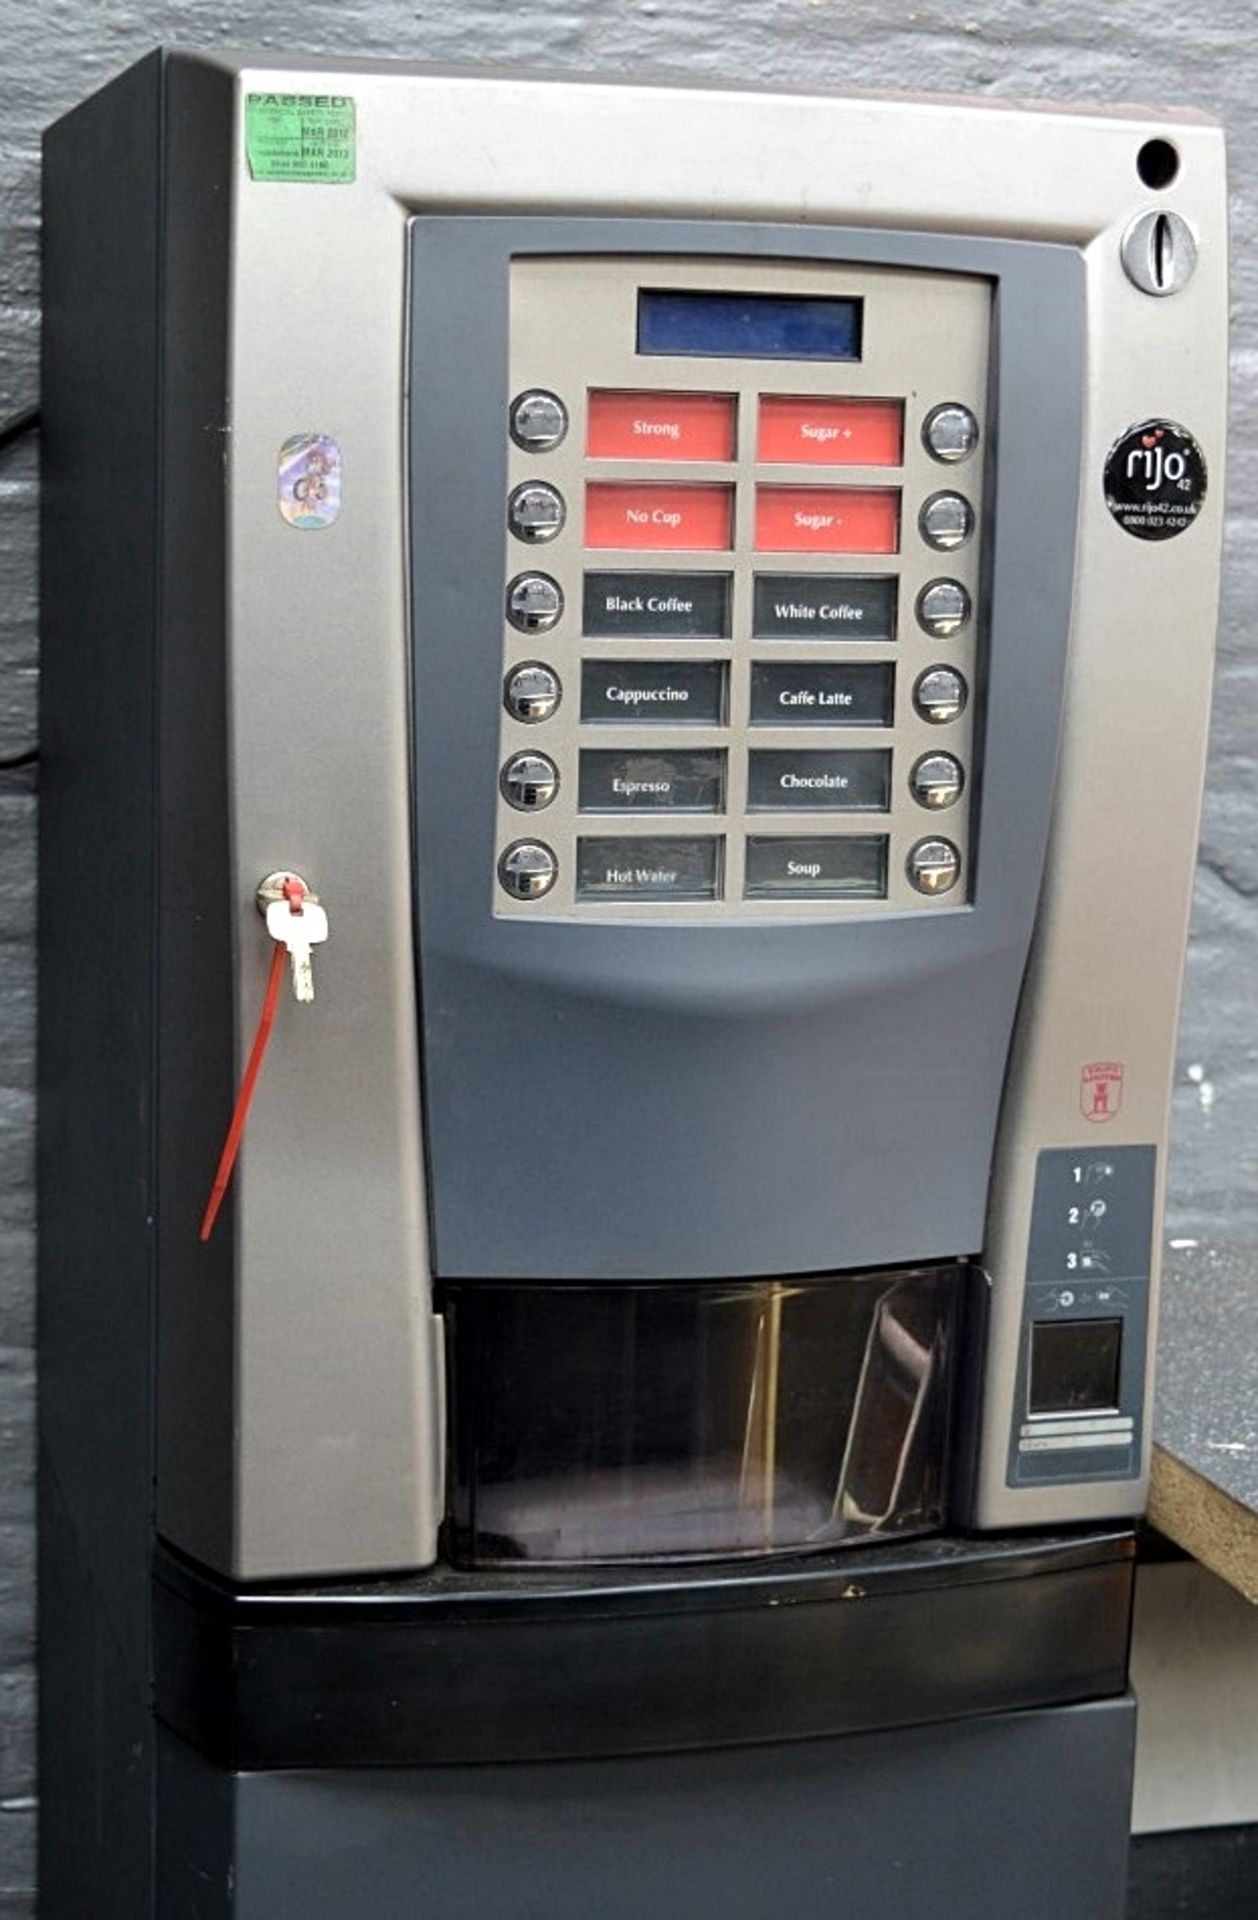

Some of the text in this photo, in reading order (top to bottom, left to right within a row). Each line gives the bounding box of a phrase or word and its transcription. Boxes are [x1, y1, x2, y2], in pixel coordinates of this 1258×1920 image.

[248, 94, 346, 107] PASSED
[303, 127, 324, 137] MAR
[303, 148, 324, 157] MAR
[633, 420, 680, 438] Strong
[800, 424, 839, 442] Sugar
[1127, 446, 1184, 490] rijo
[1177, 479, 1191, 491] 42
[1113, 502, 1196, 514] www.rijo42.co.uk
[626, 509, 681, 527] No Cup
[794, 513, 833, 530] Sugar
[606, 597, 692, 612] Black Coffee
[775, 605, 863, 620] White Coffee
[606, 687, 689, 705] Cappuccino
[780, 691, 852, 706] Caffe Latte
[612, 778, 670, 795] Espresso
[781, 774, 848, 789] Chocolate
[606, 869, 677, 883] Hot Water
[787, 862, 821, 878] Soup
[1073, 1167, 1081, 1183] 1
[1069, 1208, 1078, 1224] 2
[1067, 1252, 1077, 1269] 3
